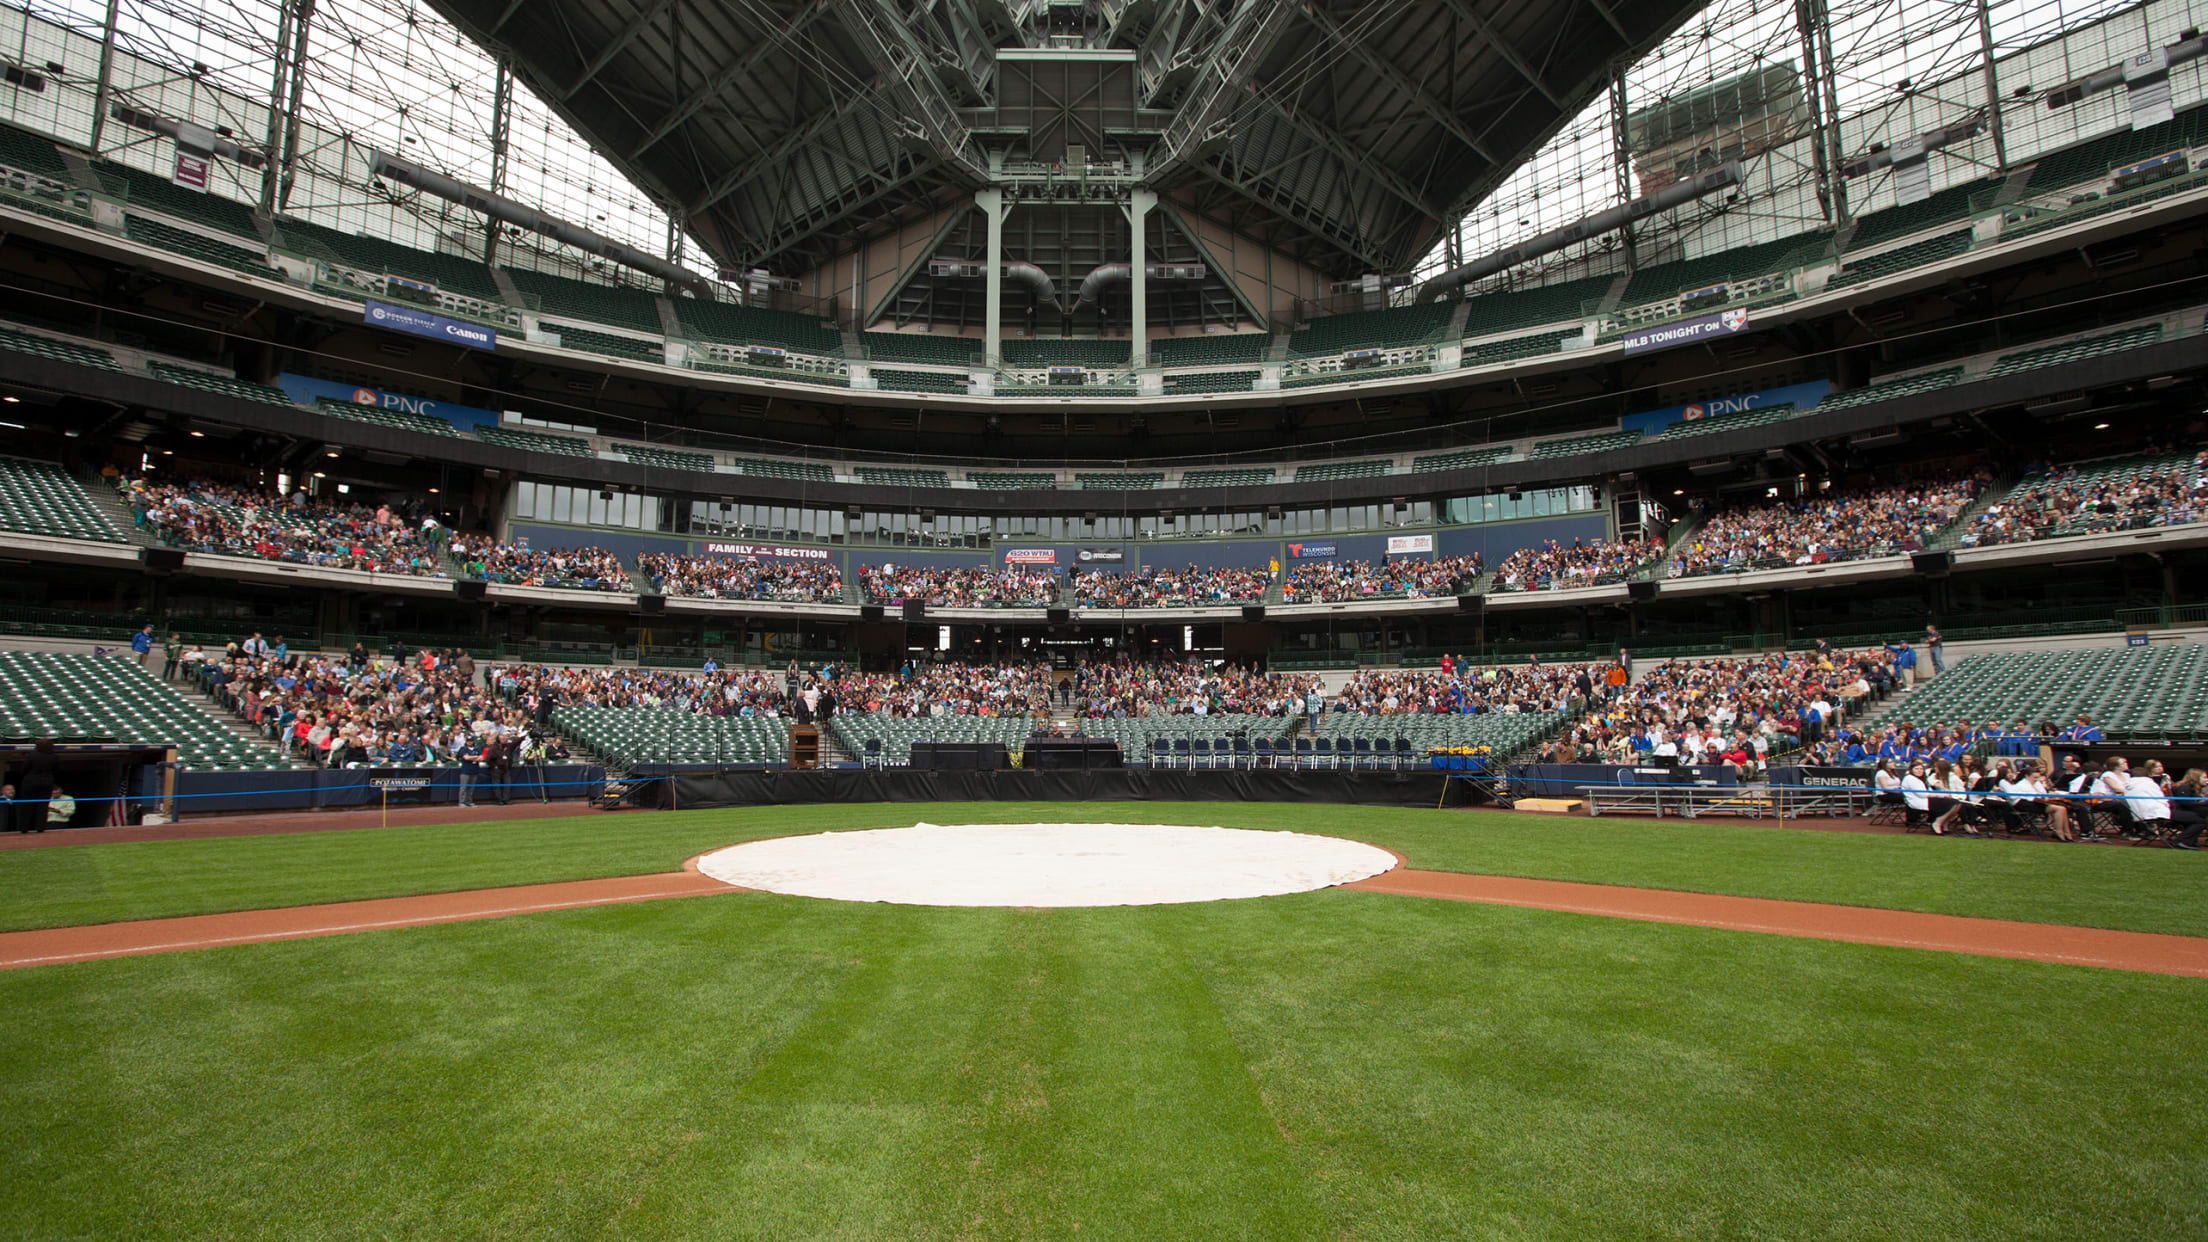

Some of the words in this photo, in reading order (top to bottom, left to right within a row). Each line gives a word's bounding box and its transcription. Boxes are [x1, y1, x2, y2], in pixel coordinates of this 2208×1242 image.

[446, 325, 488, 342] Canon
[1624, 336, 1648, 349] MLB
[1705, 321, 1720, 332] ON
[383, 393, 436, 416] PNC
[1708, 394, 1760, 417] PNC
[708, 543, 753, 554] FAMILY
[775, 547, 828, 559] SECTION
[1803, 776, 1868, 787] GENERAC
